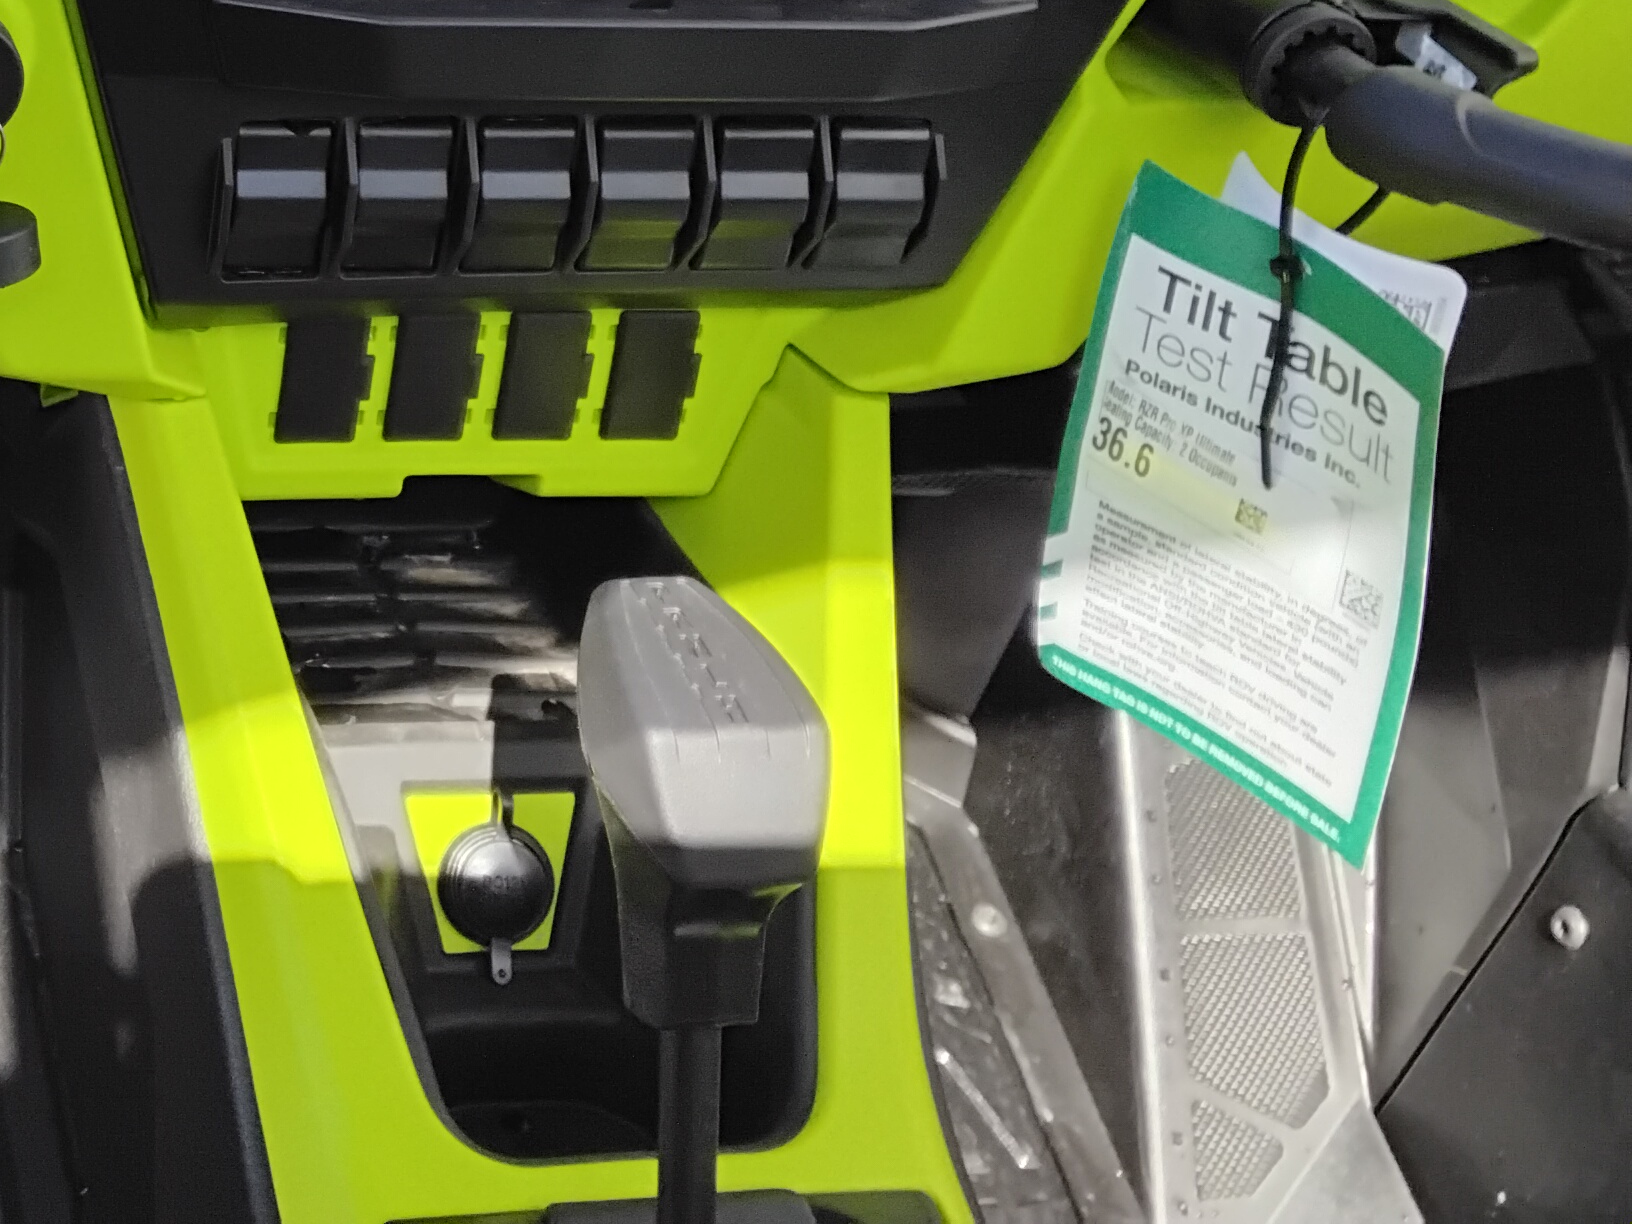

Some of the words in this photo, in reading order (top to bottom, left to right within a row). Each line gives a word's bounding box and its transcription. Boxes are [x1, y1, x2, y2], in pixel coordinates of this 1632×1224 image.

[1135, 306, 1232, 394] Test
[1248, 363, 1394, 484] Result
[1158, 265, 1238, 343] Tilt
[1258, 312, 1389, 426] Table
[1092, 415, 1156, 478] 36.6
[1125, 359, 1197, 410] Polaris
[1205, 398, 1317, 464] Indusries
[1325, 453, 1361, 488] Inc.
[1139, 400, 1160, 426] RZR
[1149, 705, 1174, 730] NOT
[1209, 742, 1263, 787] REMOVED
